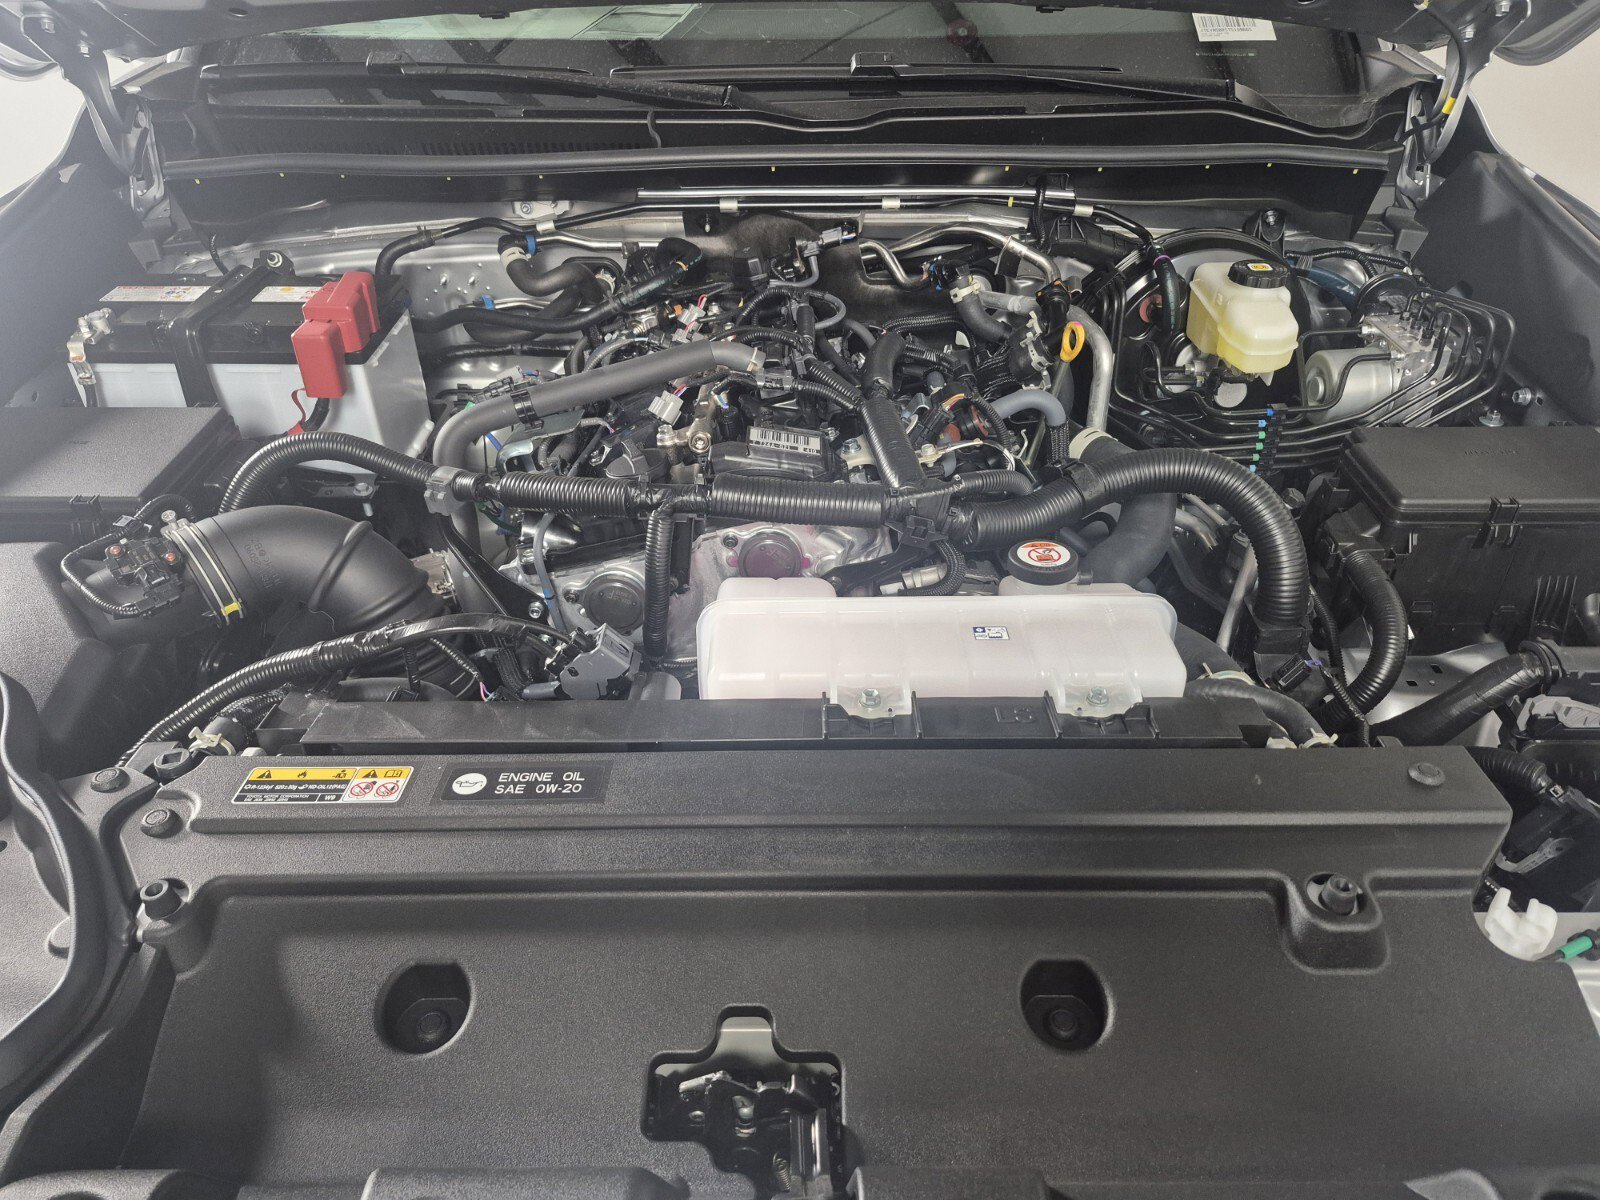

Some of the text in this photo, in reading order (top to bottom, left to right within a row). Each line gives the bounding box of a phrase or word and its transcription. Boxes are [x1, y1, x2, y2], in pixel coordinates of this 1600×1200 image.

[498, 772, 586, 782] ENGINE OIL
[494, 783, 583, 794] SAE 0W-20
